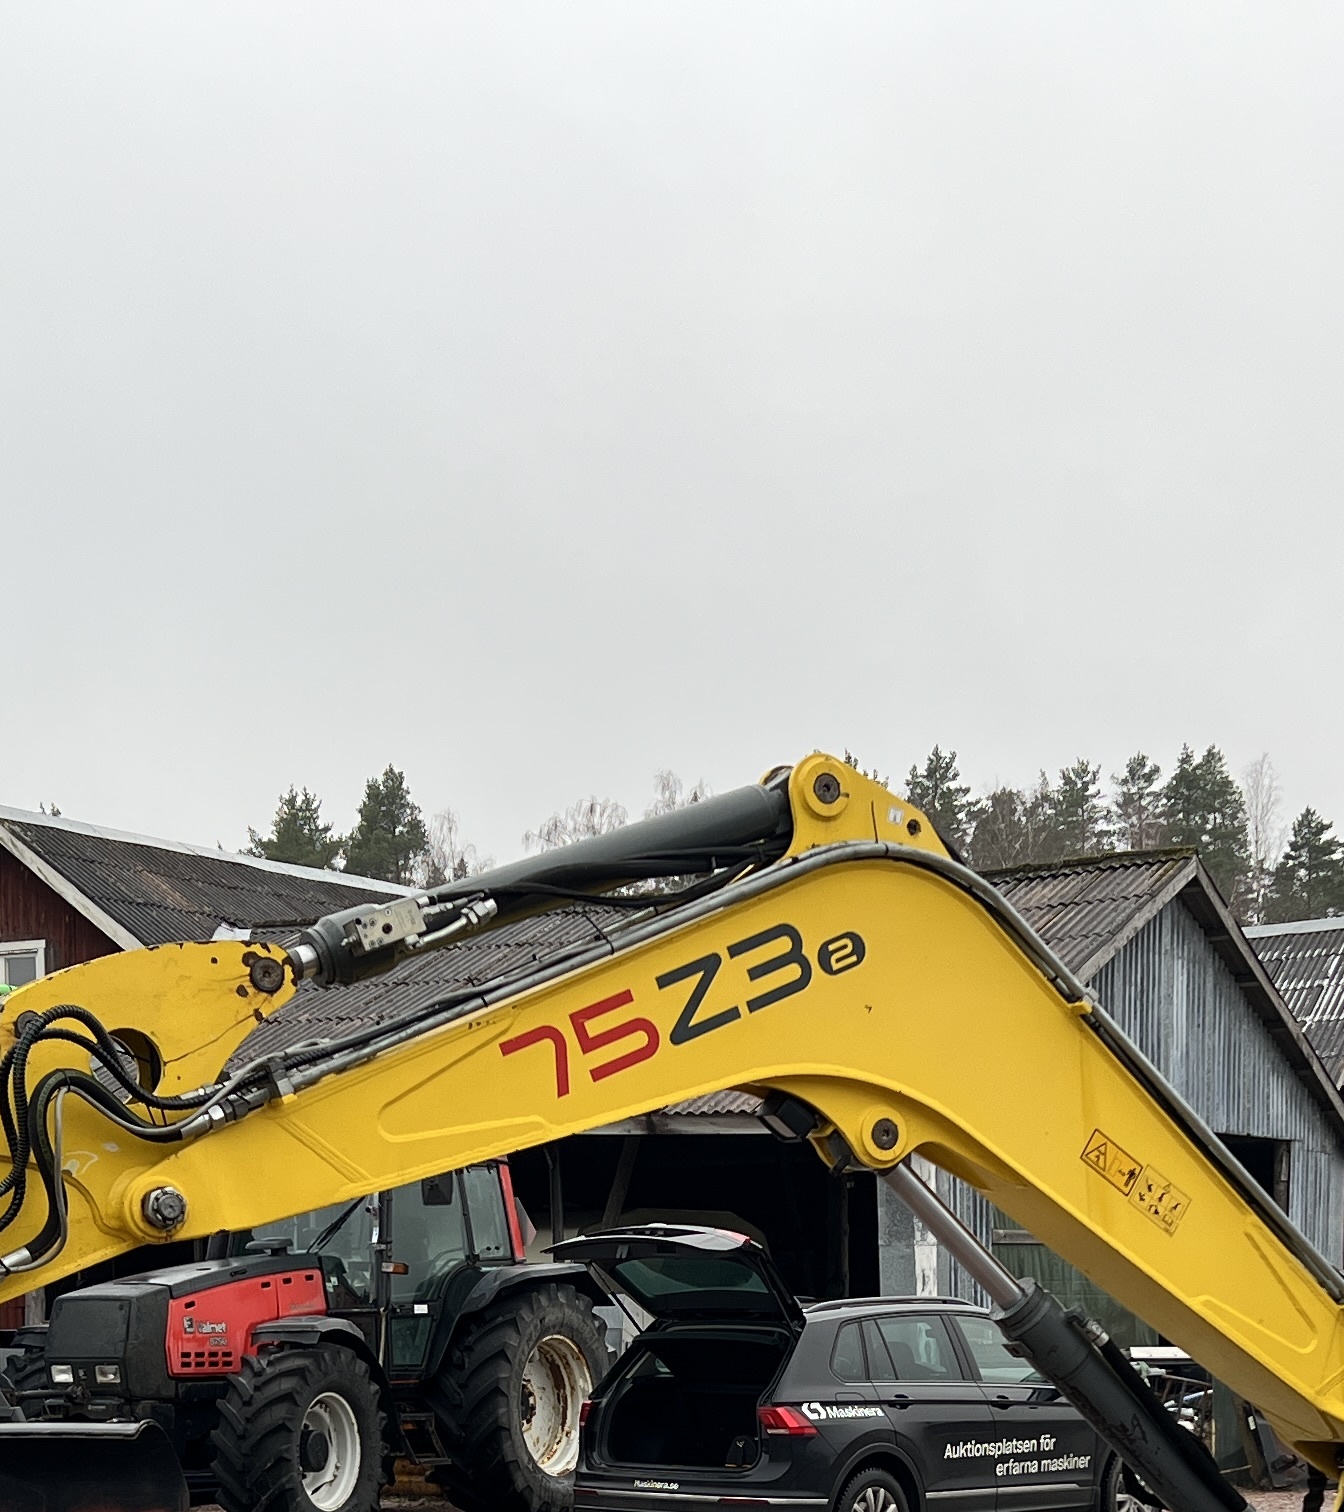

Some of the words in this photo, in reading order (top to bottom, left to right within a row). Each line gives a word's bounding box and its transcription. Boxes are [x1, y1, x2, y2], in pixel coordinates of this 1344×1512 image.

[825, 1405, 885, 1419] Maskinera
[943, 1438, 1037, 1459] Auktionsplatsen
[1040, 1434, 1056, 1451] för
[995, 1458, 1038, 1476] erfarna
[1040, 1453, 1091, 1473] maskiner
